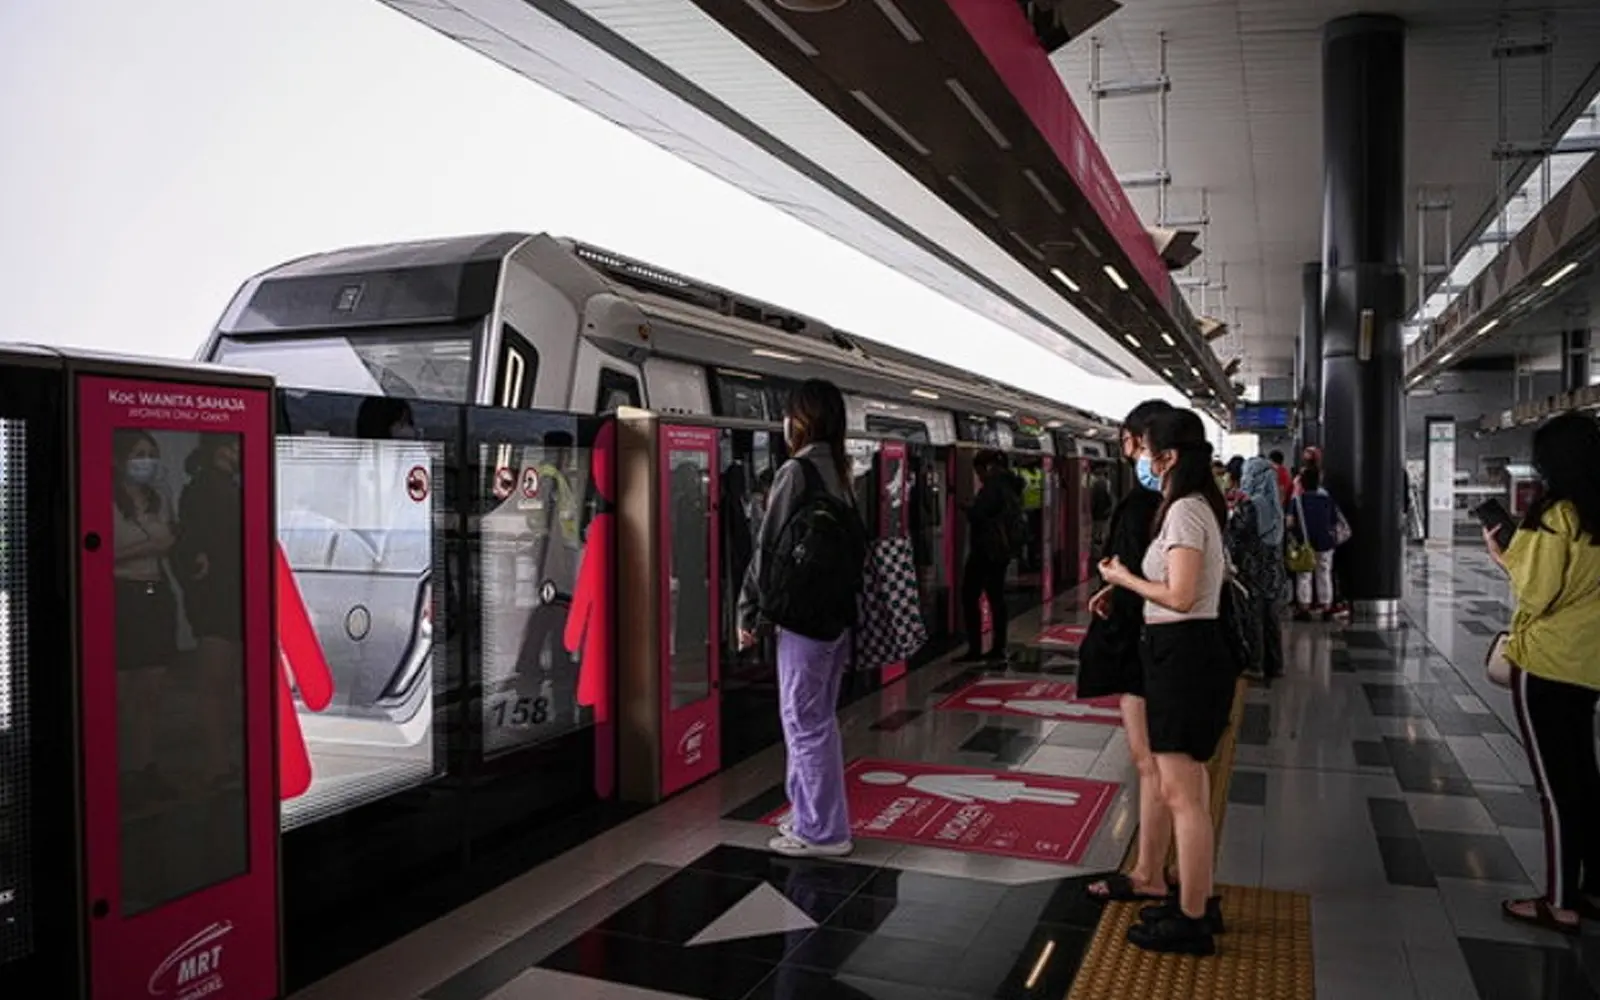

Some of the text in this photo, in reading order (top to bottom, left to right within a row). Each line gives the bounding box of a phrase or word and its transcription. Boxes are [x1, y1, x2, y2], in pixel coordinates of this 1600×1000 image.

[108, 389, 246, 412] Koc WANITA SAHAJA
[127, 407, 171, 419] WOMEN
[173, 409, 199, 421] ONLY
[492, 696, 549, 727] 158
[177, 945, 223, 986] MRT
